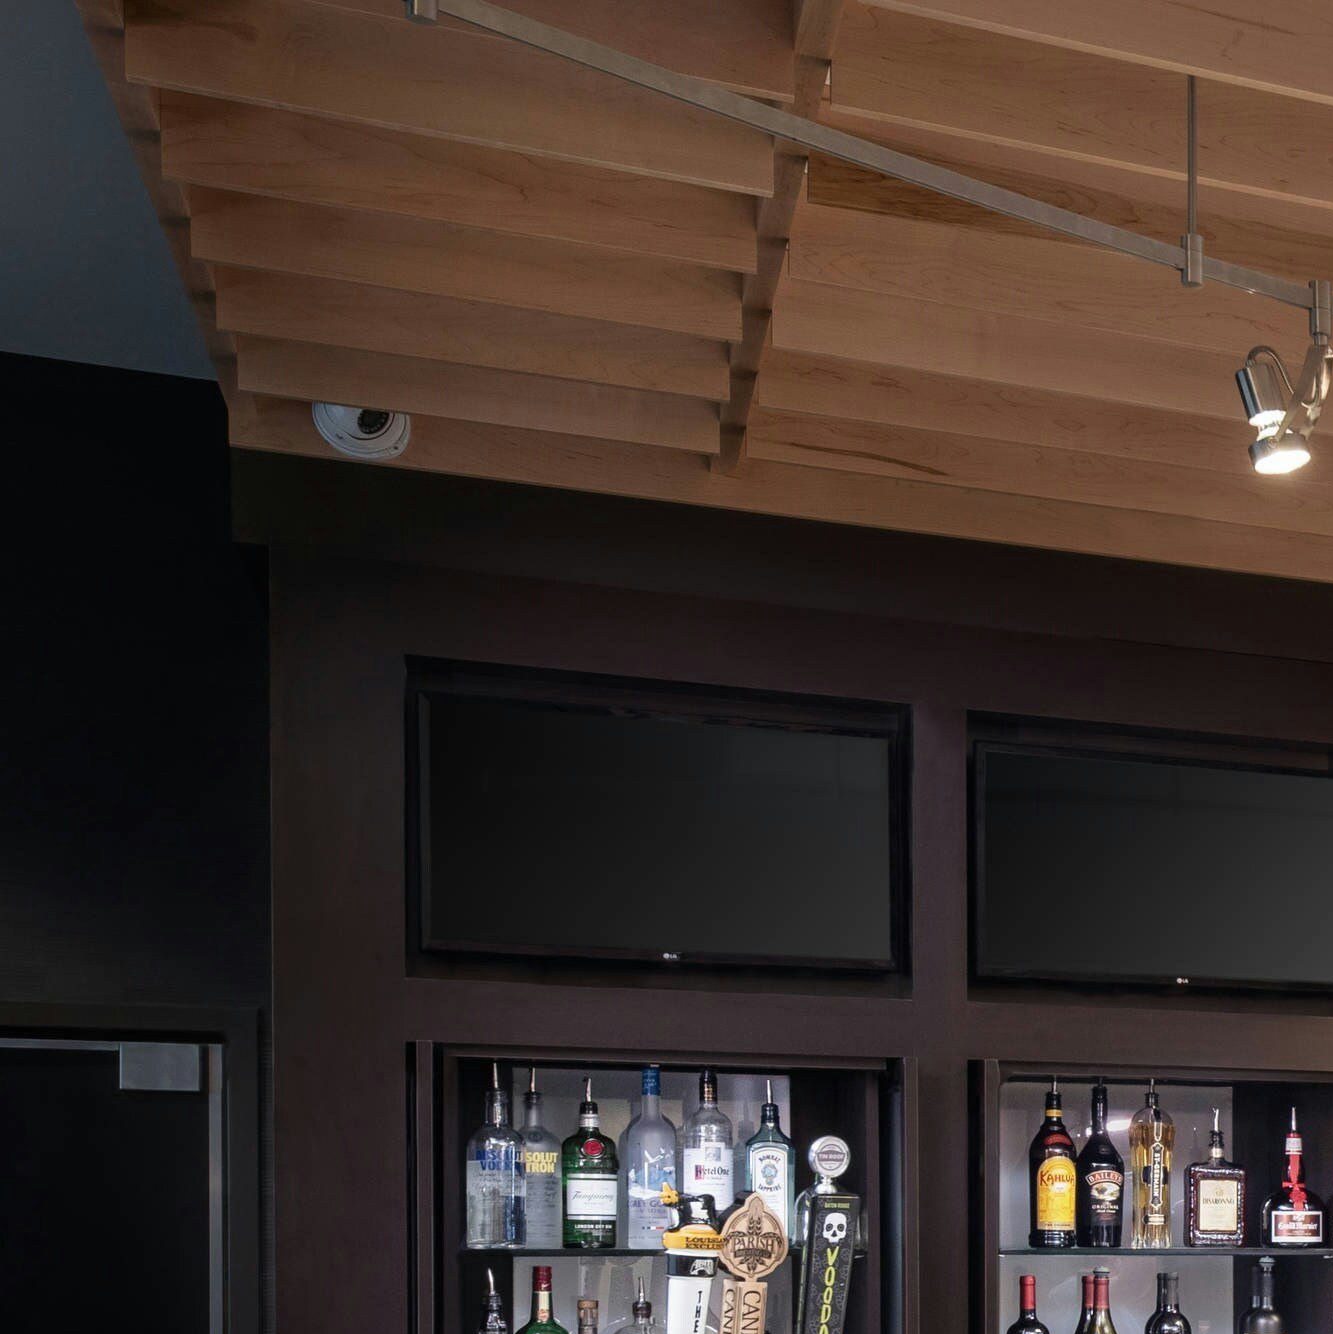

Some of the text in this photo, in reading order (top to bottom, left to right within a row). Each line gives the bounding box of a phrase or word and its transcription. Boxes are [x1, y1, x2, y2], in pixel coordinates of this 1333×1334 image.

[526, 1152, 558, 1162] SOLUT
[526, 1162, 555, 1173] TRON
[734, 1235, 774, 1250] PARISH
[694, 1290, 703, 1334] THE
